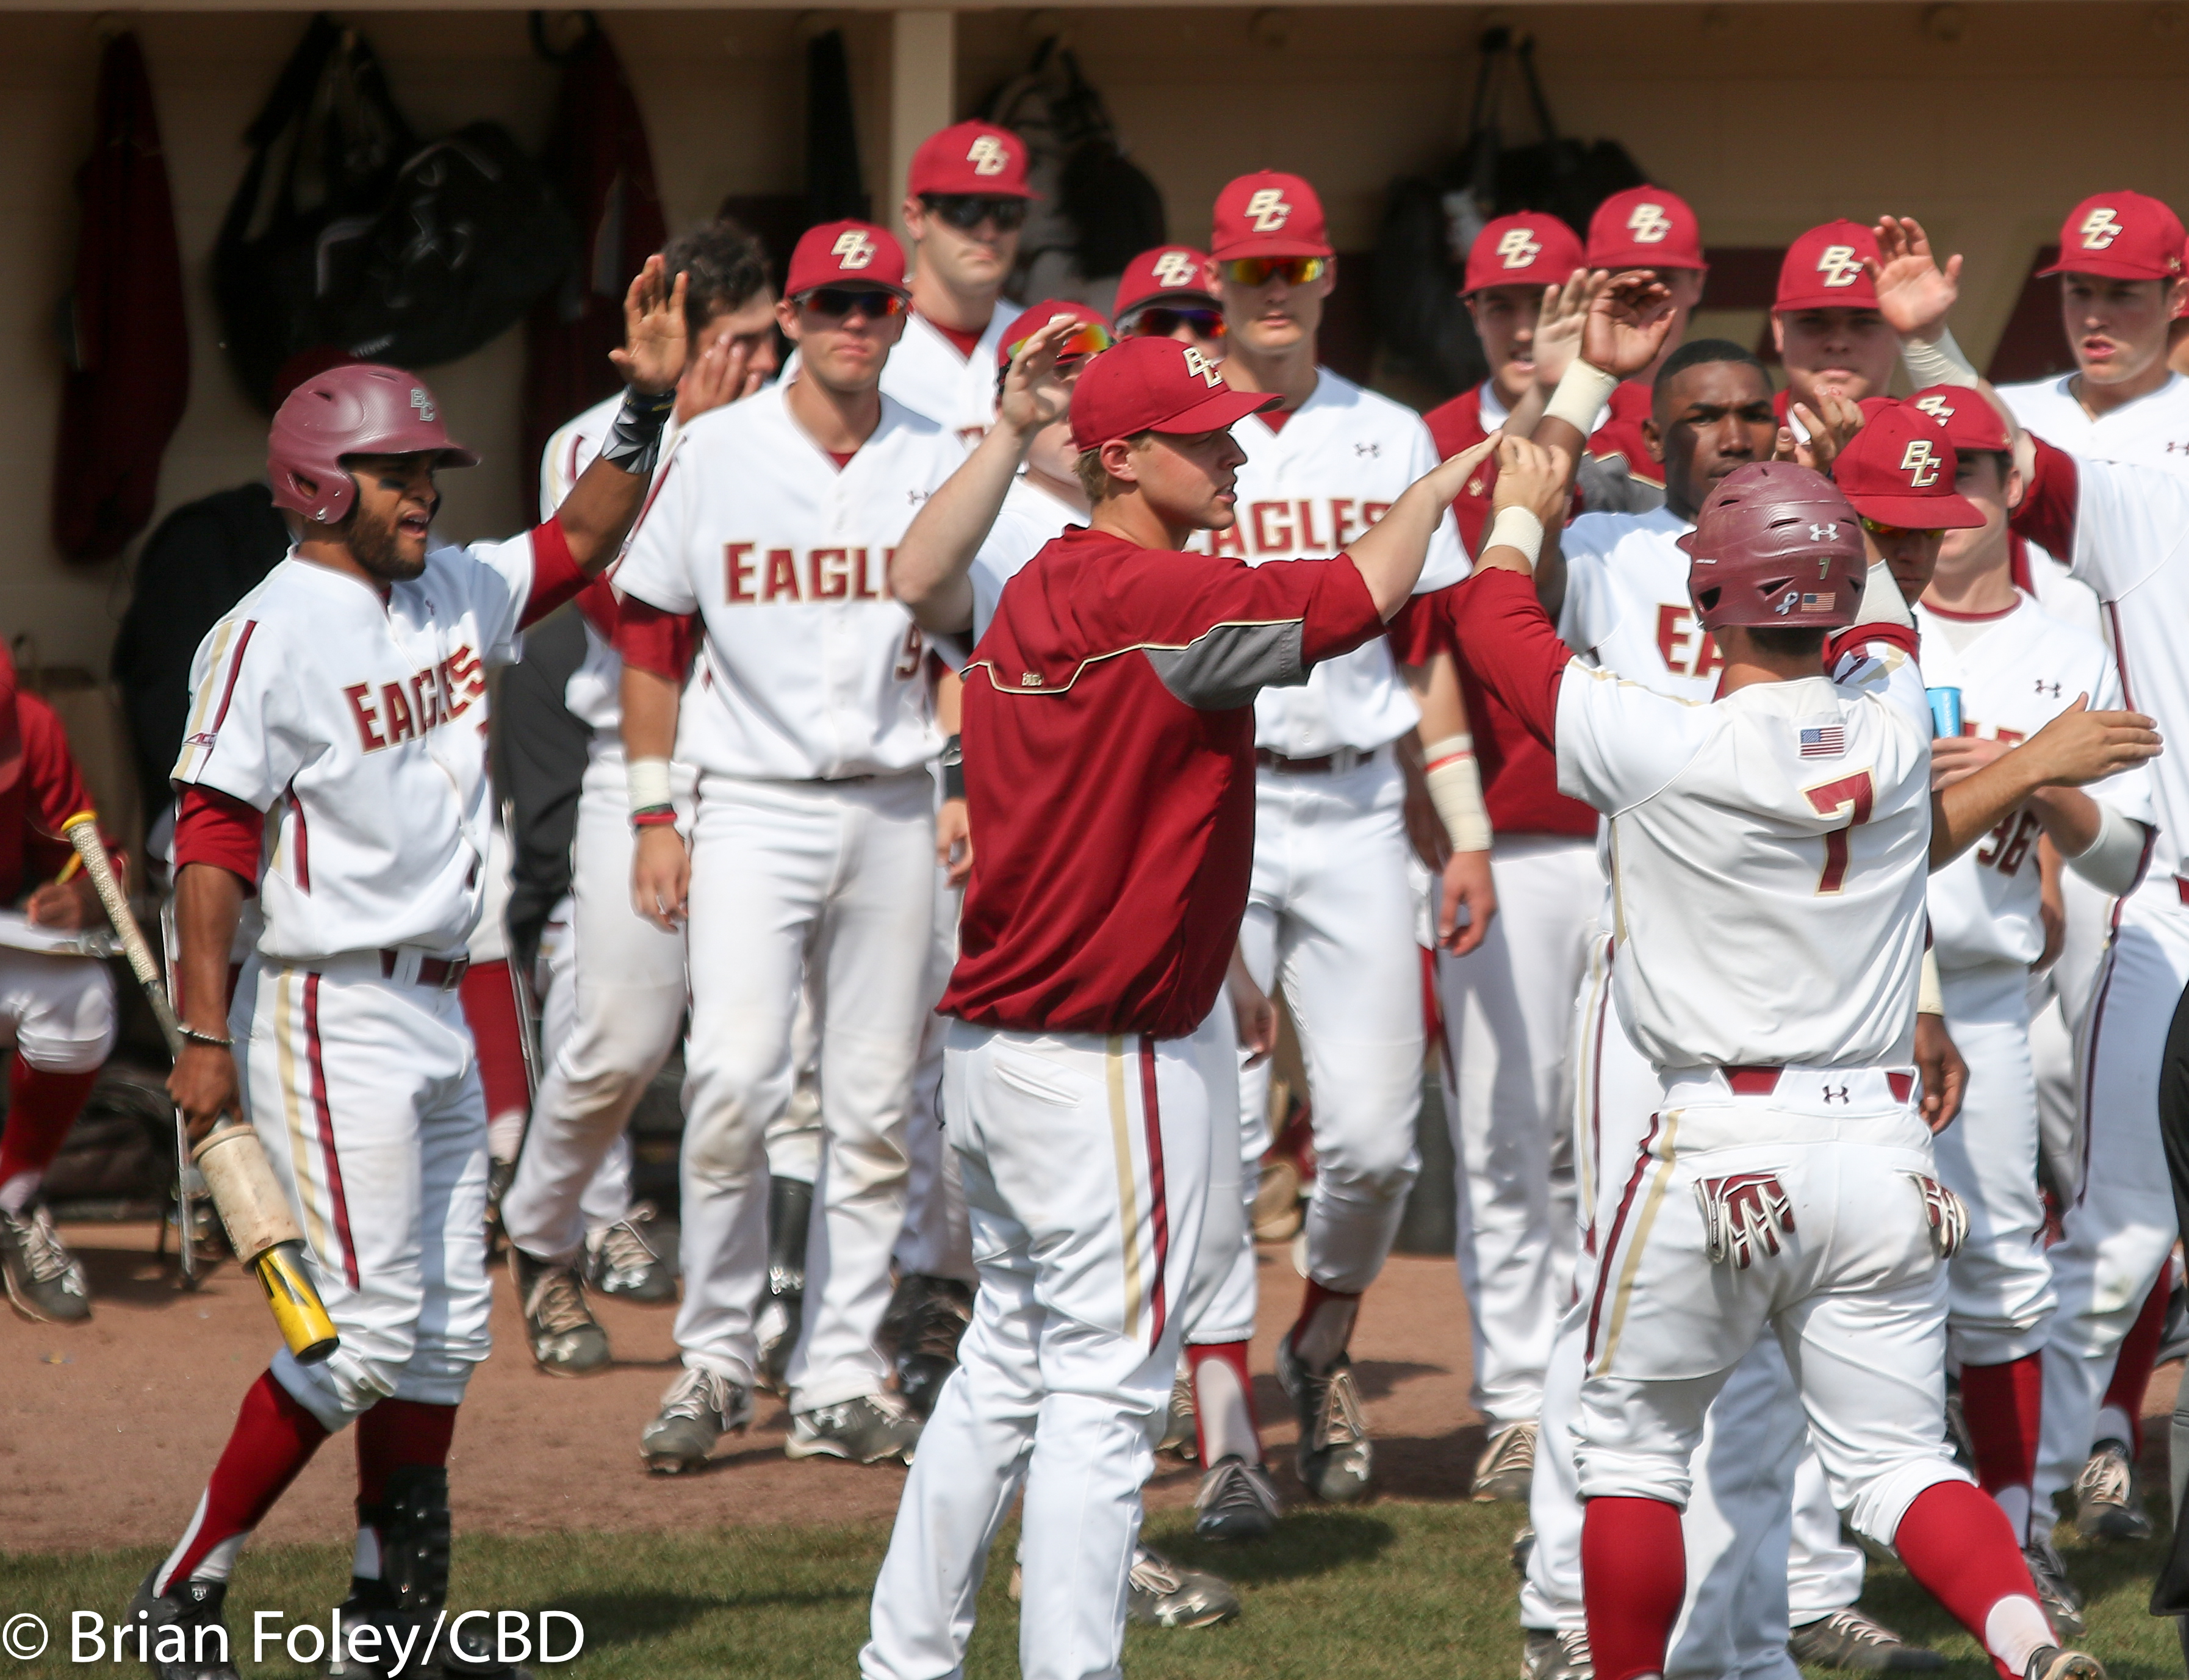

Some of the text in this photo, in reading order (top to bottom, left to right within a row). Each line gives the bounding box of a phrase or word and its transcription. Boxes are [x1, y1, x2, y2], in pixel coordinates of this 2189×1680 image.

[966, 135, 1009, 175] BC
[1245, 188, 1293, 232] BC
[1626, 203, 1672, 243] BC
[2080, 208, 2123, 250] BC
[831, 229, 876, 270] BC
[1497, 228, 1542, 268] BC
[1816, 245, 1863, 287] BC
[1152, 251, 1197, 287] BC
[1182, 346, 1224, 388] BC
[410, 388, 436, 422] BC
[1900, 439, 1942, 487] BC
[1817, 558, 1831, 580] 7
[1800, 766, 1877, 897] 7
